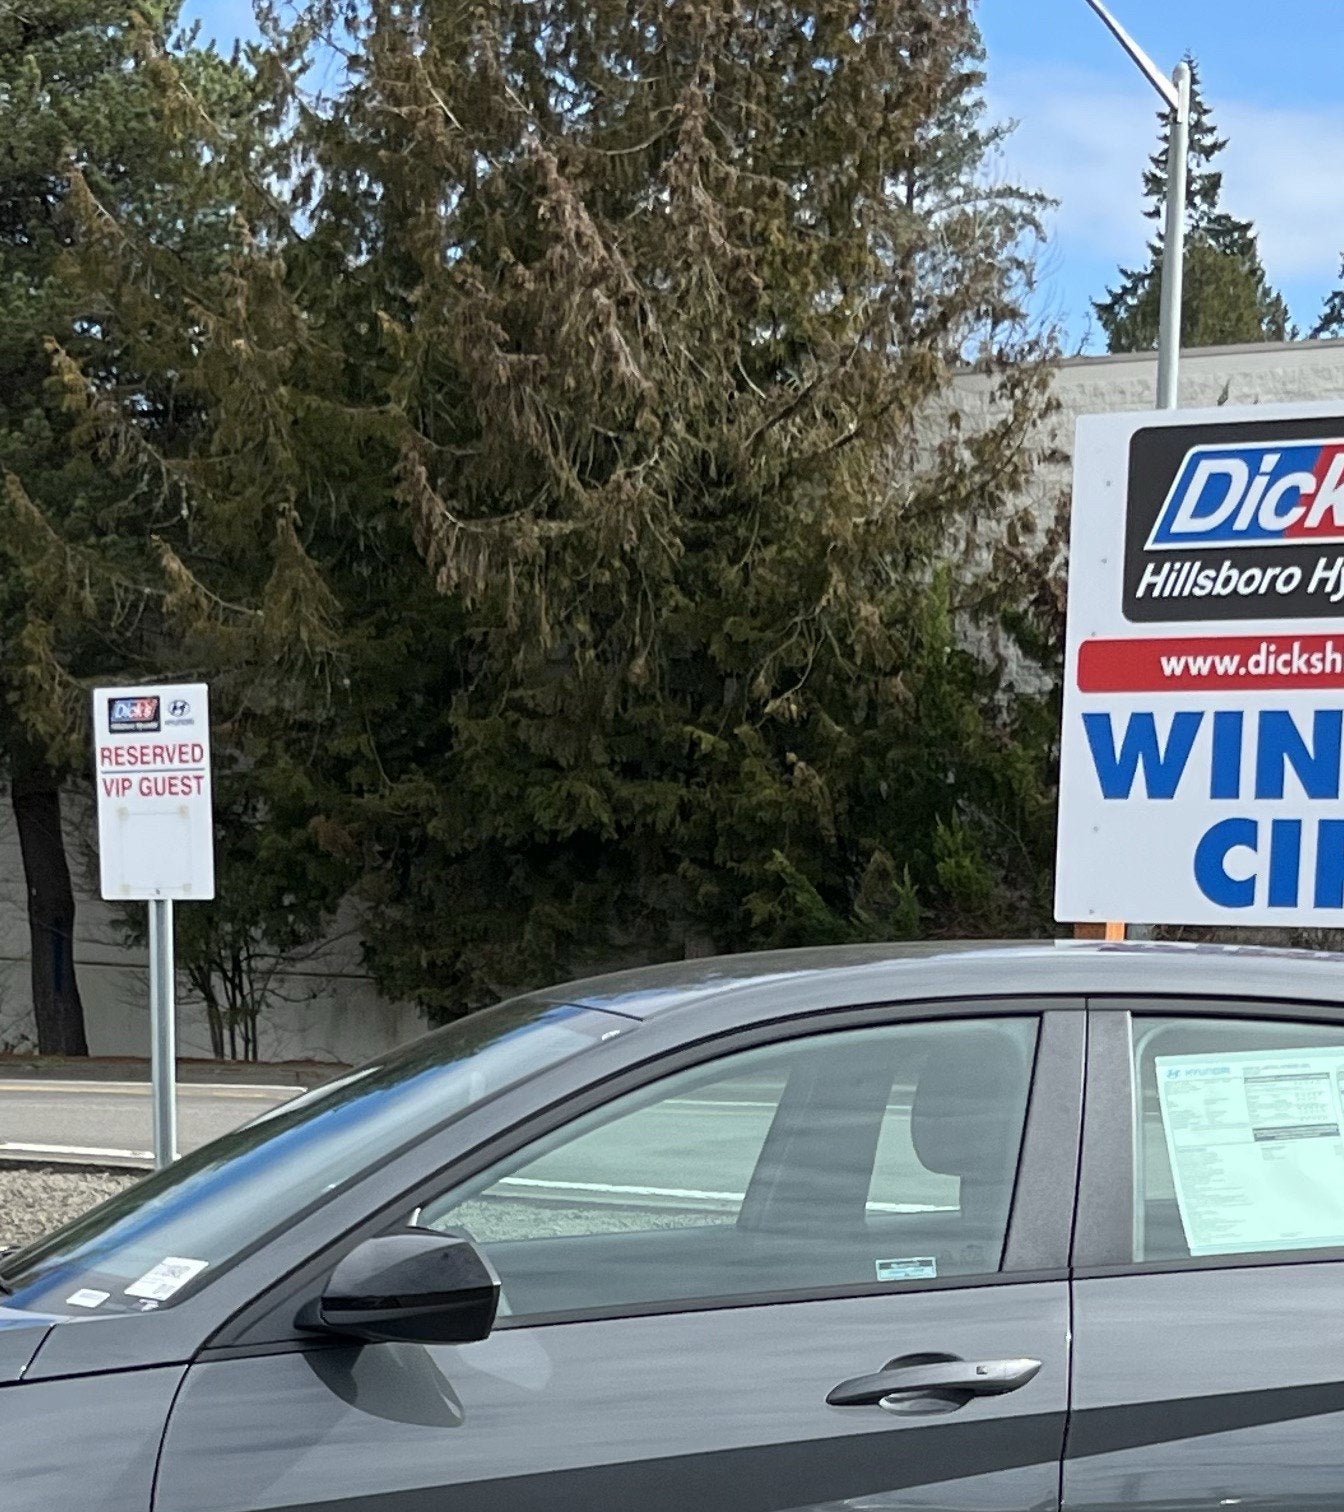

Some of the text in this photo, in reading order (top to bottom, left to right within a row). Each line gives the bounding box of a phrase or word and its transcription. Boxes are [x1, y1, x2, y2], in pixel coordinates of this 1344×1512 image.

[1135, 559, 1303, 600] Hillsboro
[100, 743, 204, 767] RESERVED
[102, 775, 205, 798] VIP GUEST
